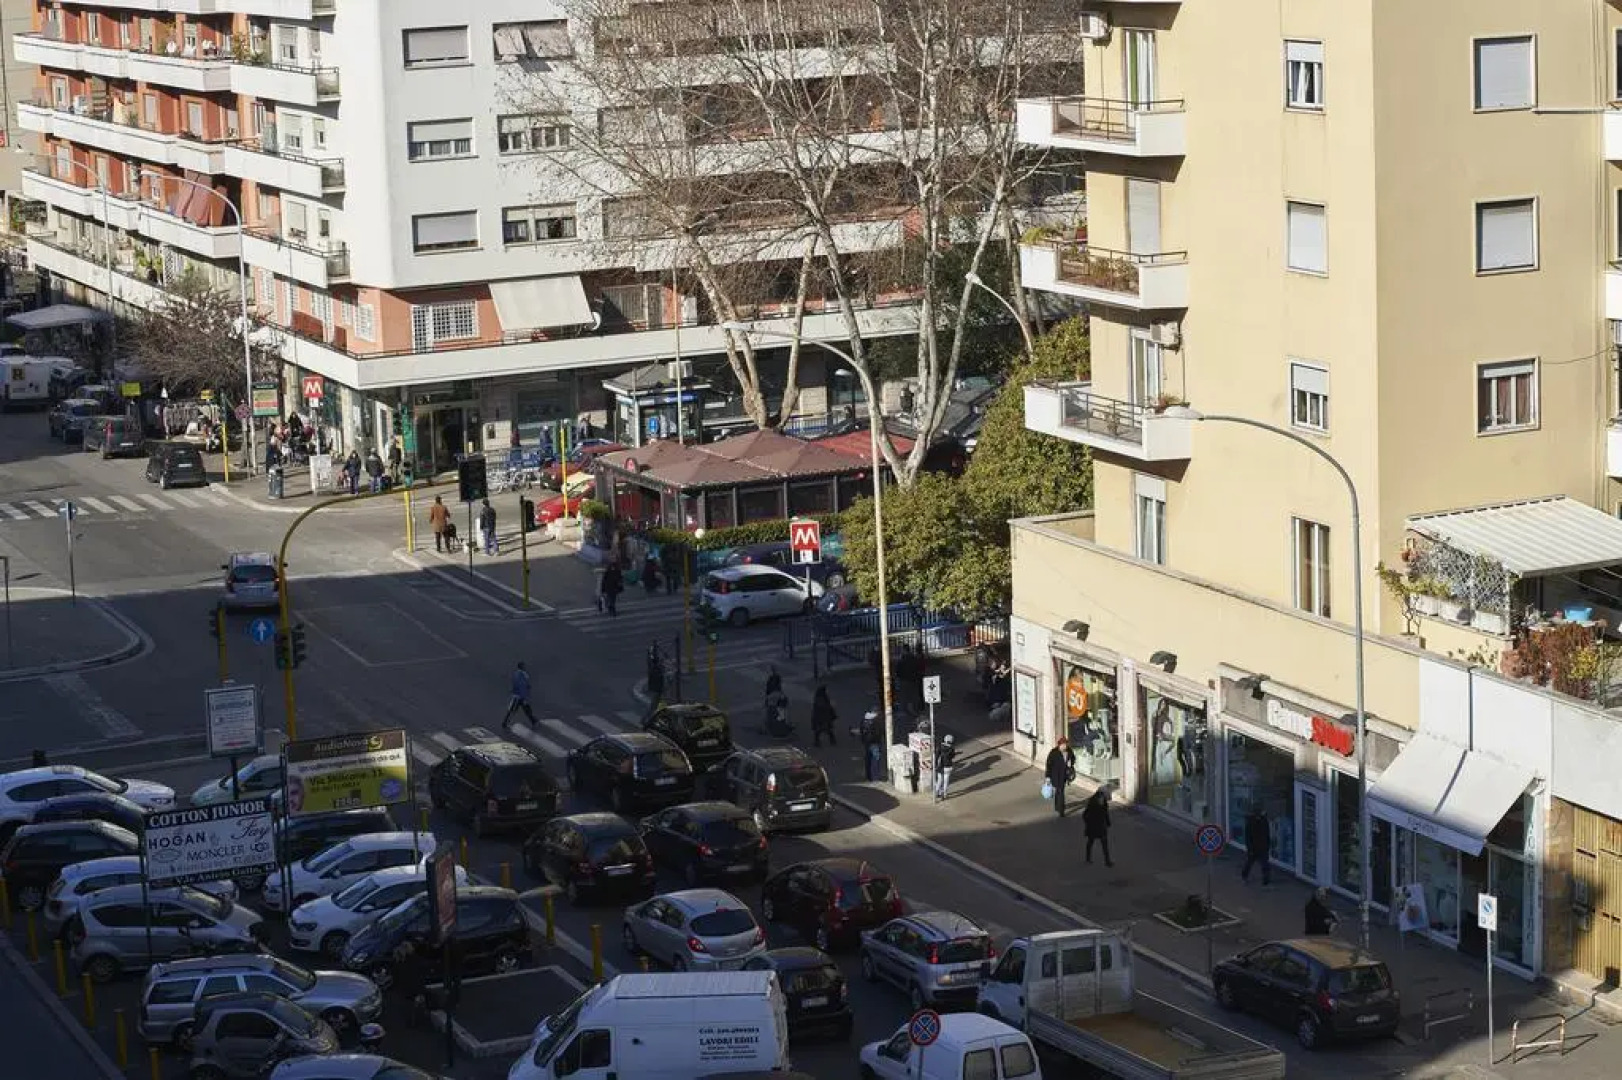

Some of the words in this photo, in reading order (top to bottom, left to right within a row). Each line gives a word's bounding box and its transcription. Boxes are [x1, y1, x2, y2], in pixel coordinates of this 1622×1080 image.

[305, 381, 322, 395] M
[795, 528, 818, 545] M
[149, 808, 210, 829] COTTON
[212, 799, 267, 822] JUNIOR
[231, 813, 272, 840] Fay
[148, 831, 206, 850] HOGAN
[186, 844, 245, 861] MONCLER
[734, 1036, 759, 1044] EDILI
